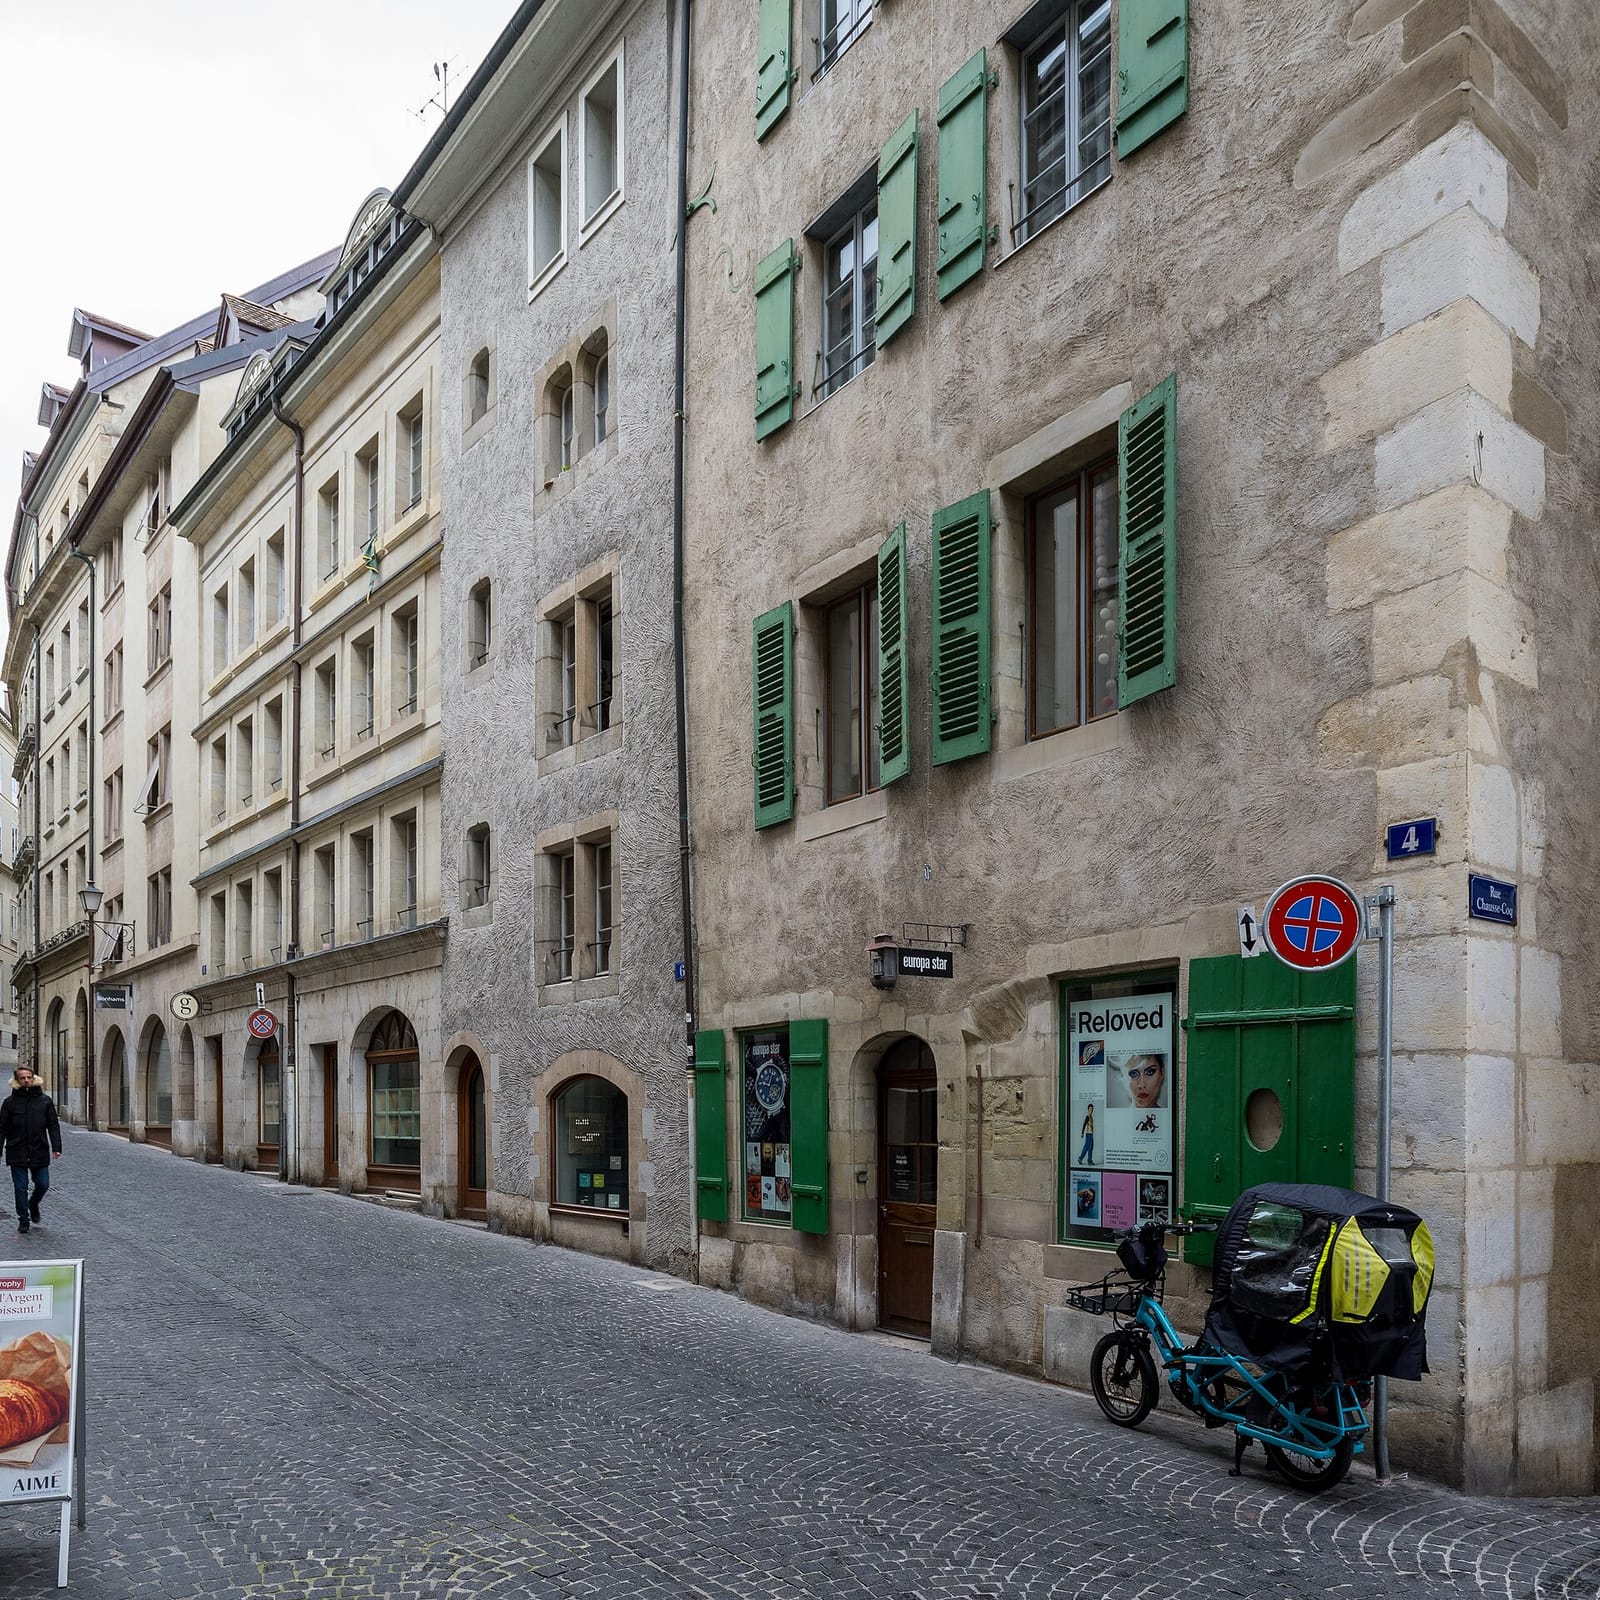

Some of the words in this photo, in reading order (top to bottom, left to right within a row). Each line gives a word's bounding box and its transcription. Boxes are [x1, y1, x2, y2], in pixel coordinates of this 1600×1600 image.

[1401, 826, 1420, 852] 4
[1490, 885, 1502, 899] Rue
[1476, 897, 1514, 919] Chausse-Coq
[679, 964, 686, 977] 6
[903, 956, 930, 973] europa
[931, 956, 948, 970] star
[180, 997, 192, 1015] g
[1078, 1004, 1164, 1034] Reloved
